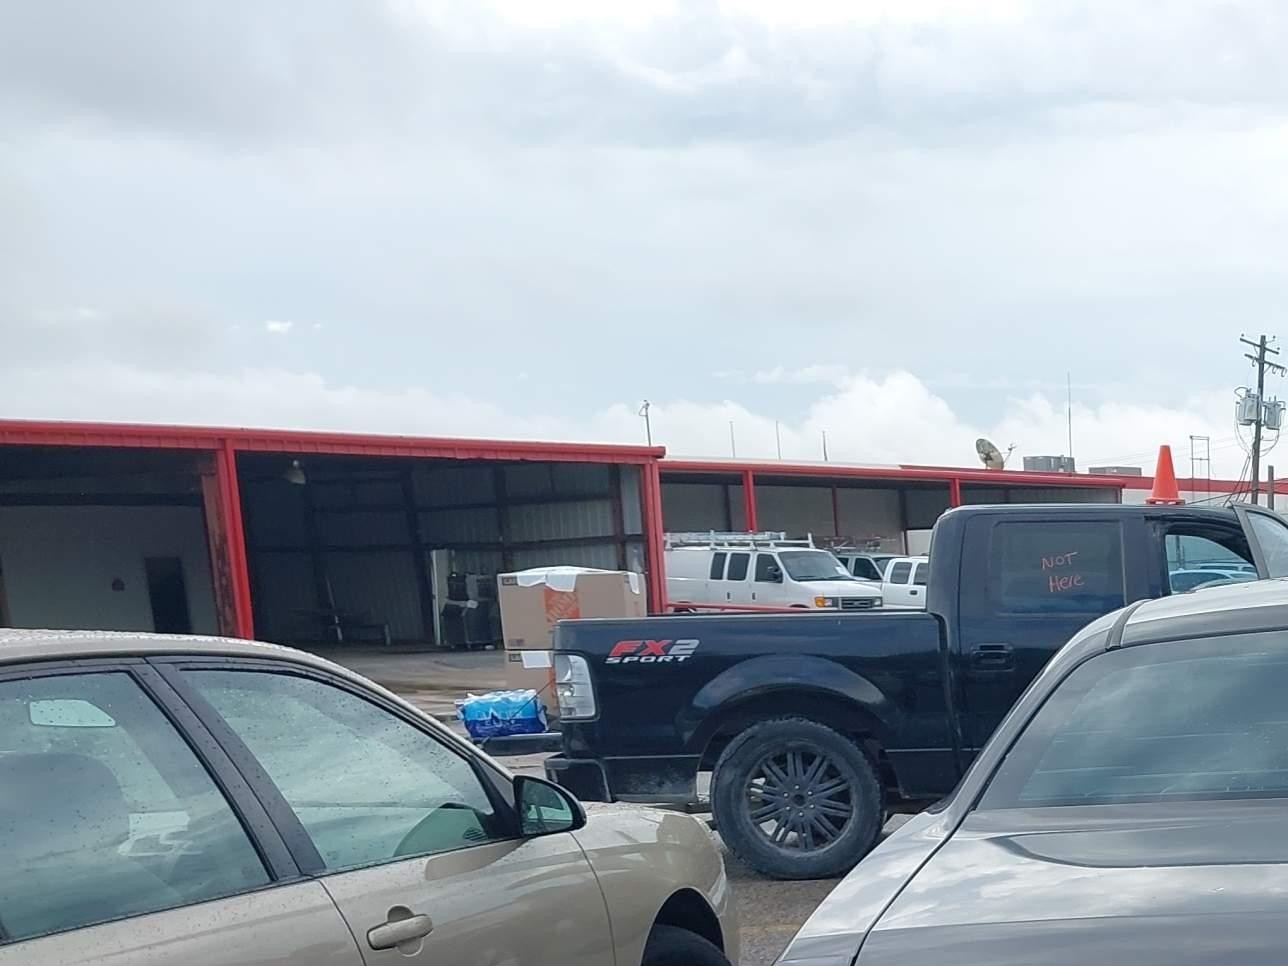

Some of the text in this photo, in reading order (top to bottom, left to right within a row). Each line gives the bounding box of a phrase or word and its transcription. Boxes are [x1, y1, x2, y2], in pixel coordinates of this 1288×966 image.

[1041, 551, 1078, 570] NOT
[609, 639, 700, 657] FX2
[605, 655, 691, 664] SPORT
